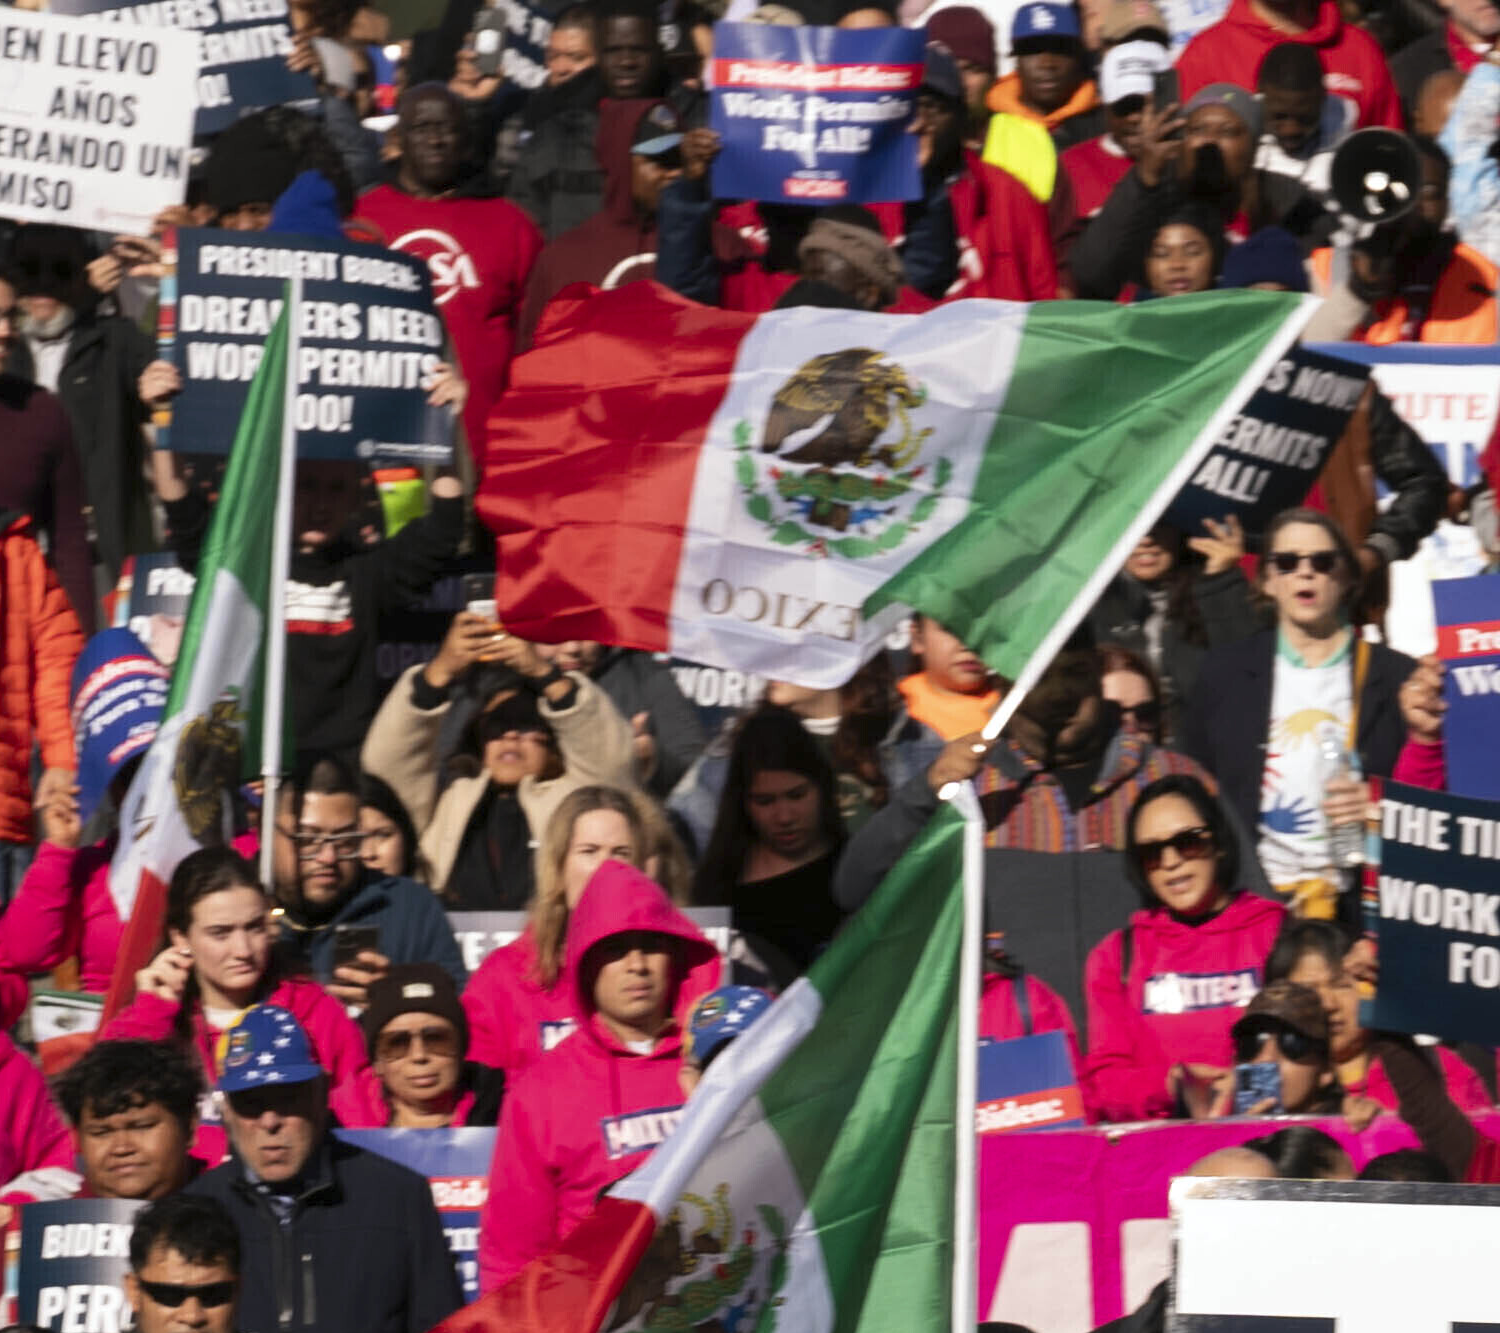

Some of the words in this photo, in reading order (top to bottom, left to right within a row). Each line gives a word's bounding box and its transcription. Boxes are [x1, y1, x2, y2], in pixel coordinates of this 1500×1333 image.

[56, 32, 158, 76] LLEVO
[47, 80, 138, 127] AÑOS
[723, 93, 800, 120] Work
[138, 146, 184, 179] UN
[1381, 799, 1451, 852] THE
